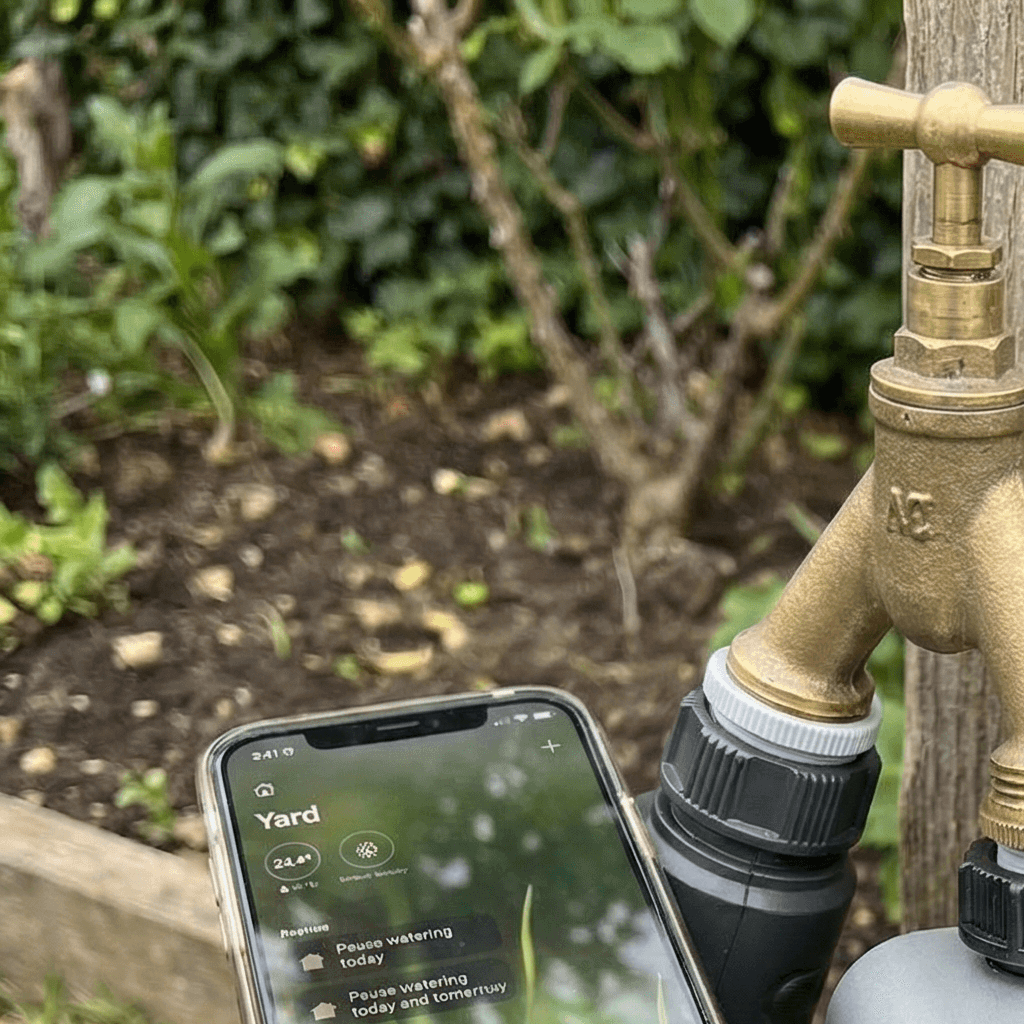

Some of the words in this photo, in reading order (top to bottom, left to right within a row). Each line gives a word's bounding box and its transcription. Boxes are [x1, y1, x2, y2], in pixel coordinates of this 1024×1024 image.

[253, 804, 321, 830] Yard
[385, 927, 453, 946] watering
[340, 953, 384, 969] today
[351, 1001, 396, 1018] today
[400, 993, 430, 1010] and
